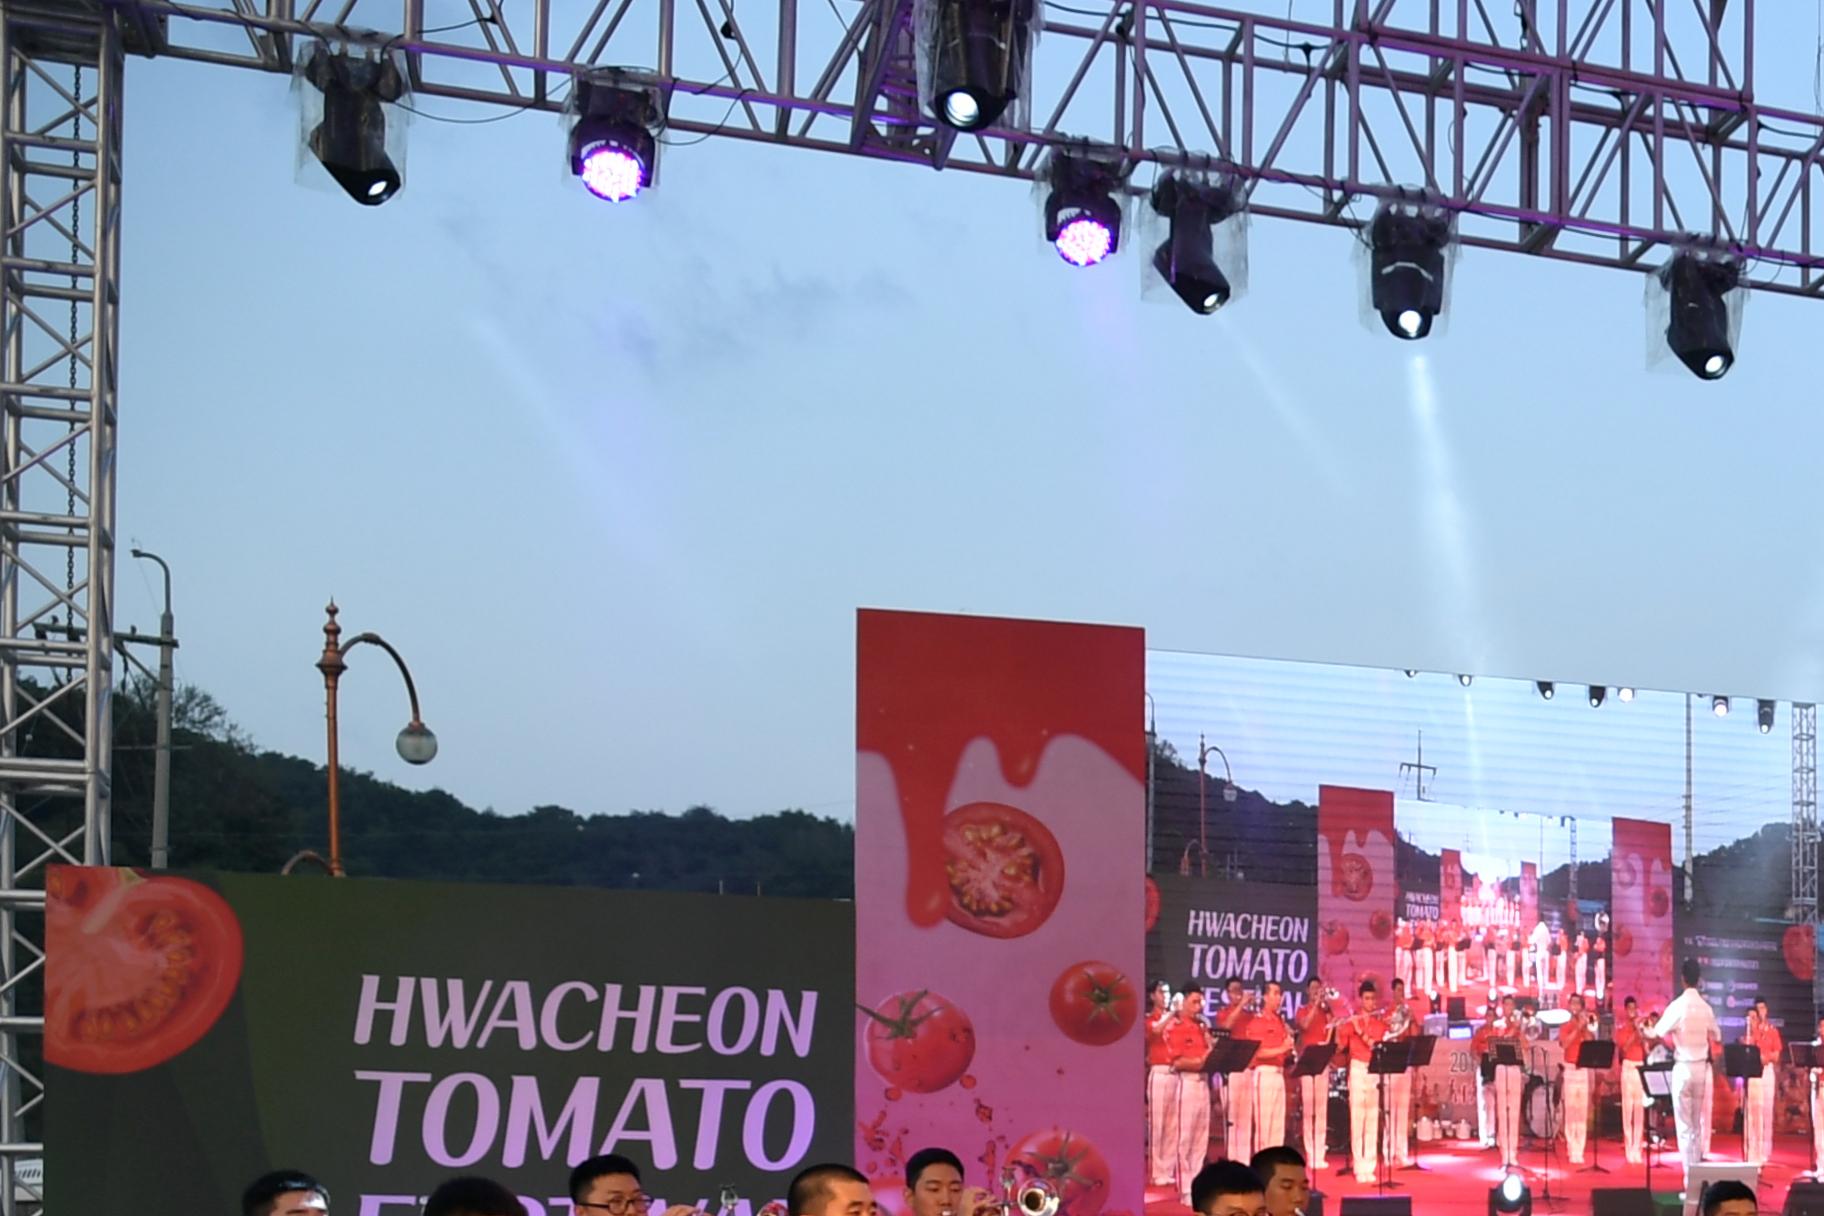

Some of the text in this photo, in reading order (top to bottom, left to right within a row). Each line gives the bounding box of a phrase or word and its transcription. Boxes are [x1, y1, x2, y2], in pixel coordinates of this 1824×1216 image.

[1188, 909, 1308, 943] HWACHEON
[1188, 943, 1308, 983] TOMATO
[354, 973, 818, 1058] HWACHEON
[354, 1069, 816, 1172] TOMATO
